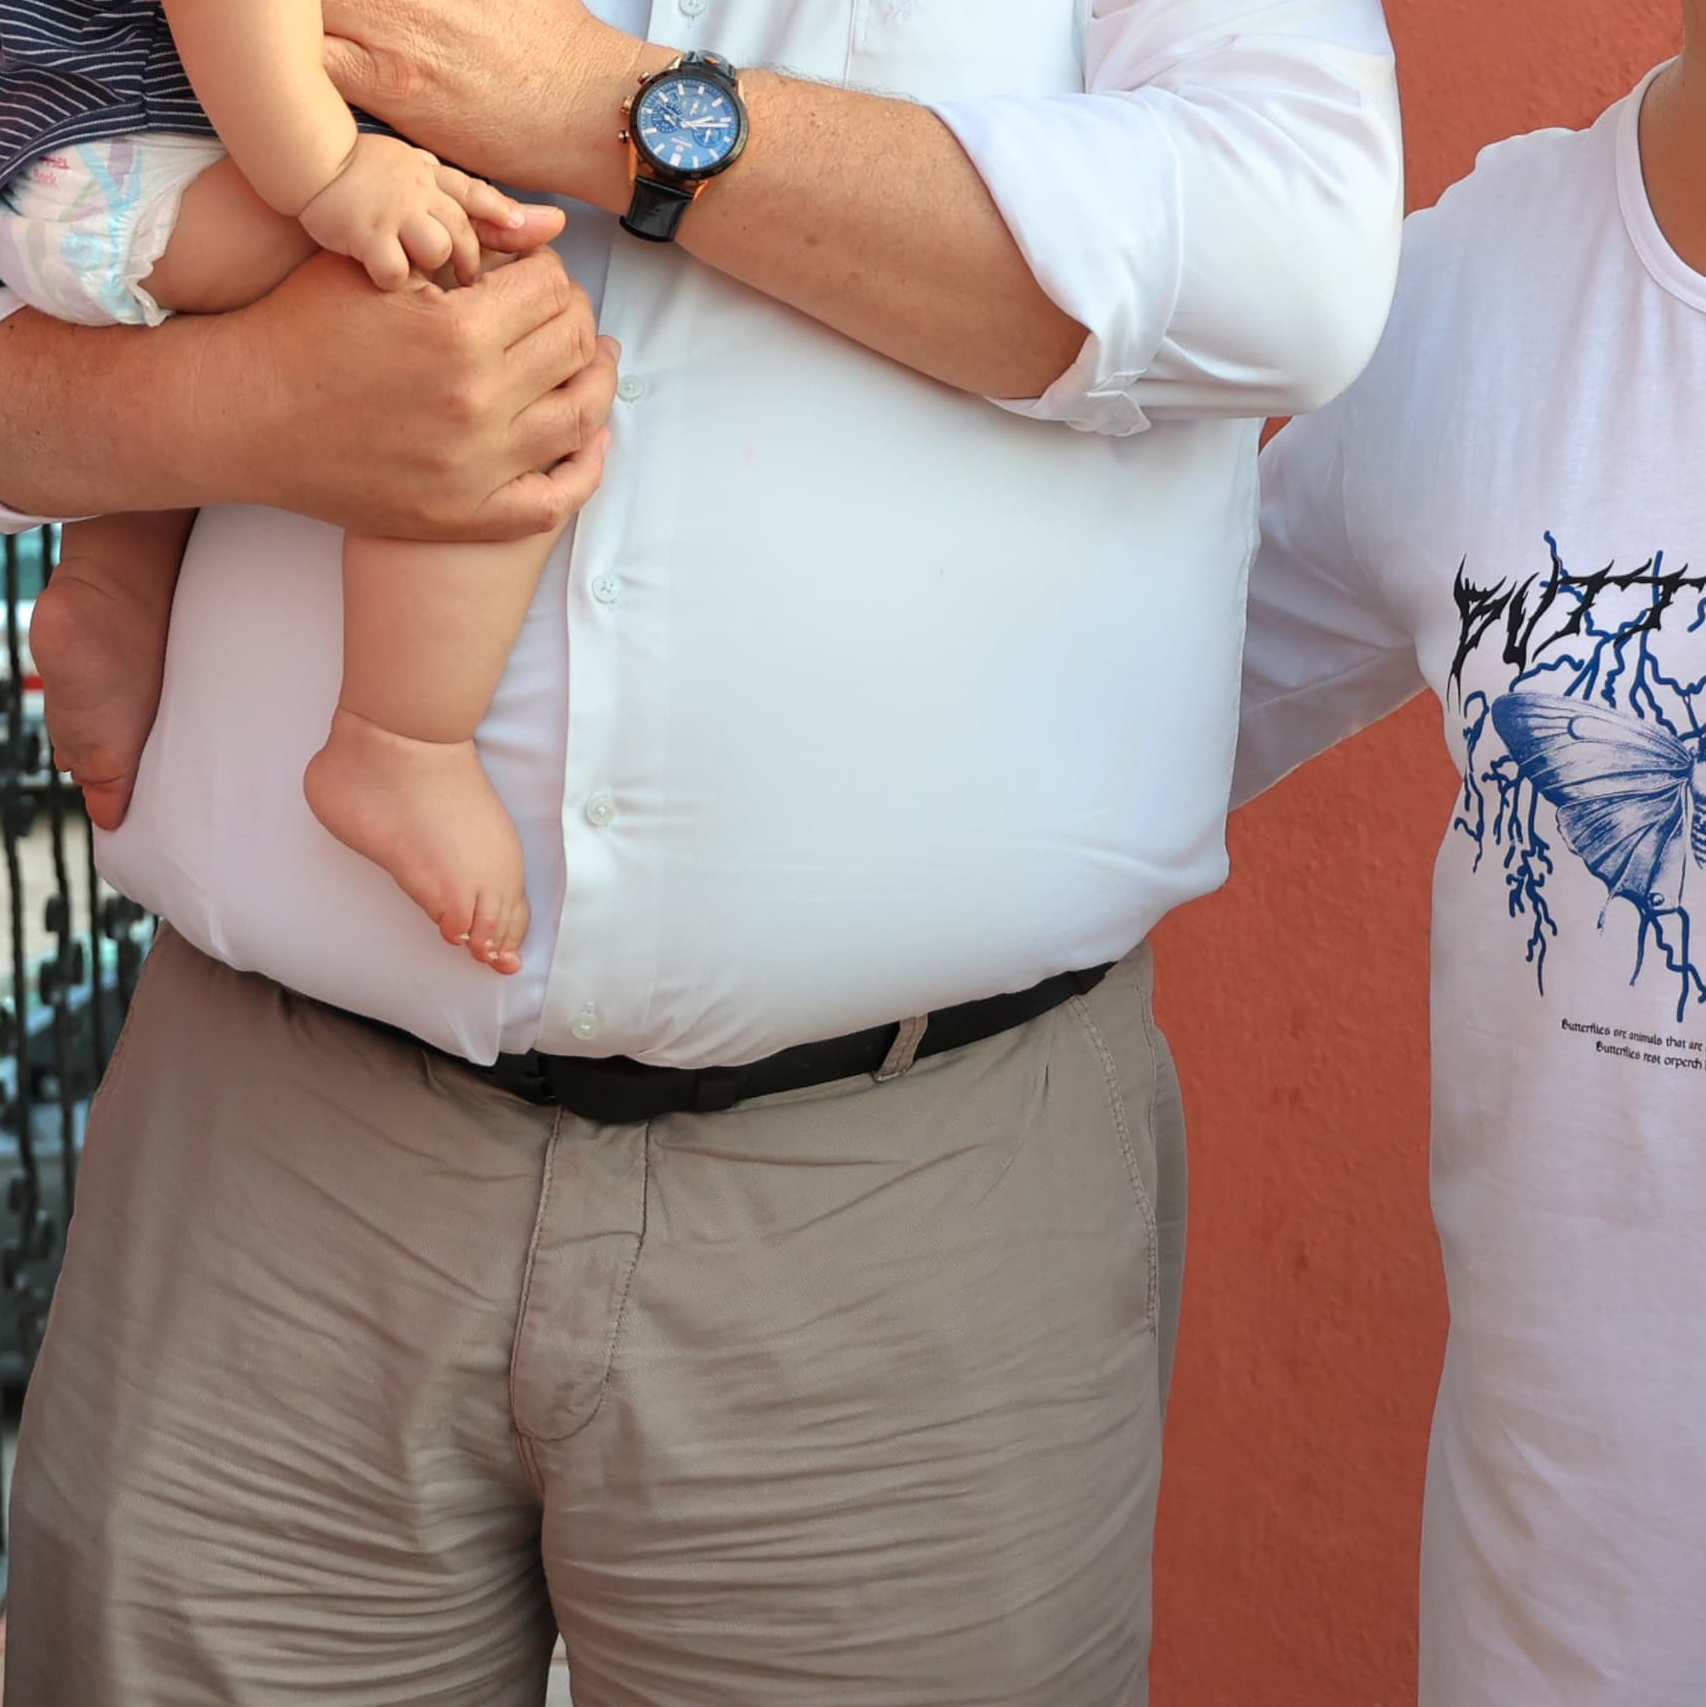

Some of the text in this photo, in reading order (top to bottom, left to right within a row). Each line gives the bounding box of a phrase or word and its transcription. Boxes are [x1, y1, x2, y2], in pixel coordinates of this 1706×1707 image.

[1561, 1018, 1611, 1036] Butterflies
[1666, 1036, 1686, 1049] that
[1688, 1040, 1703, 1052] are
[1595, 1040, 1641, 1060] Butterflies
